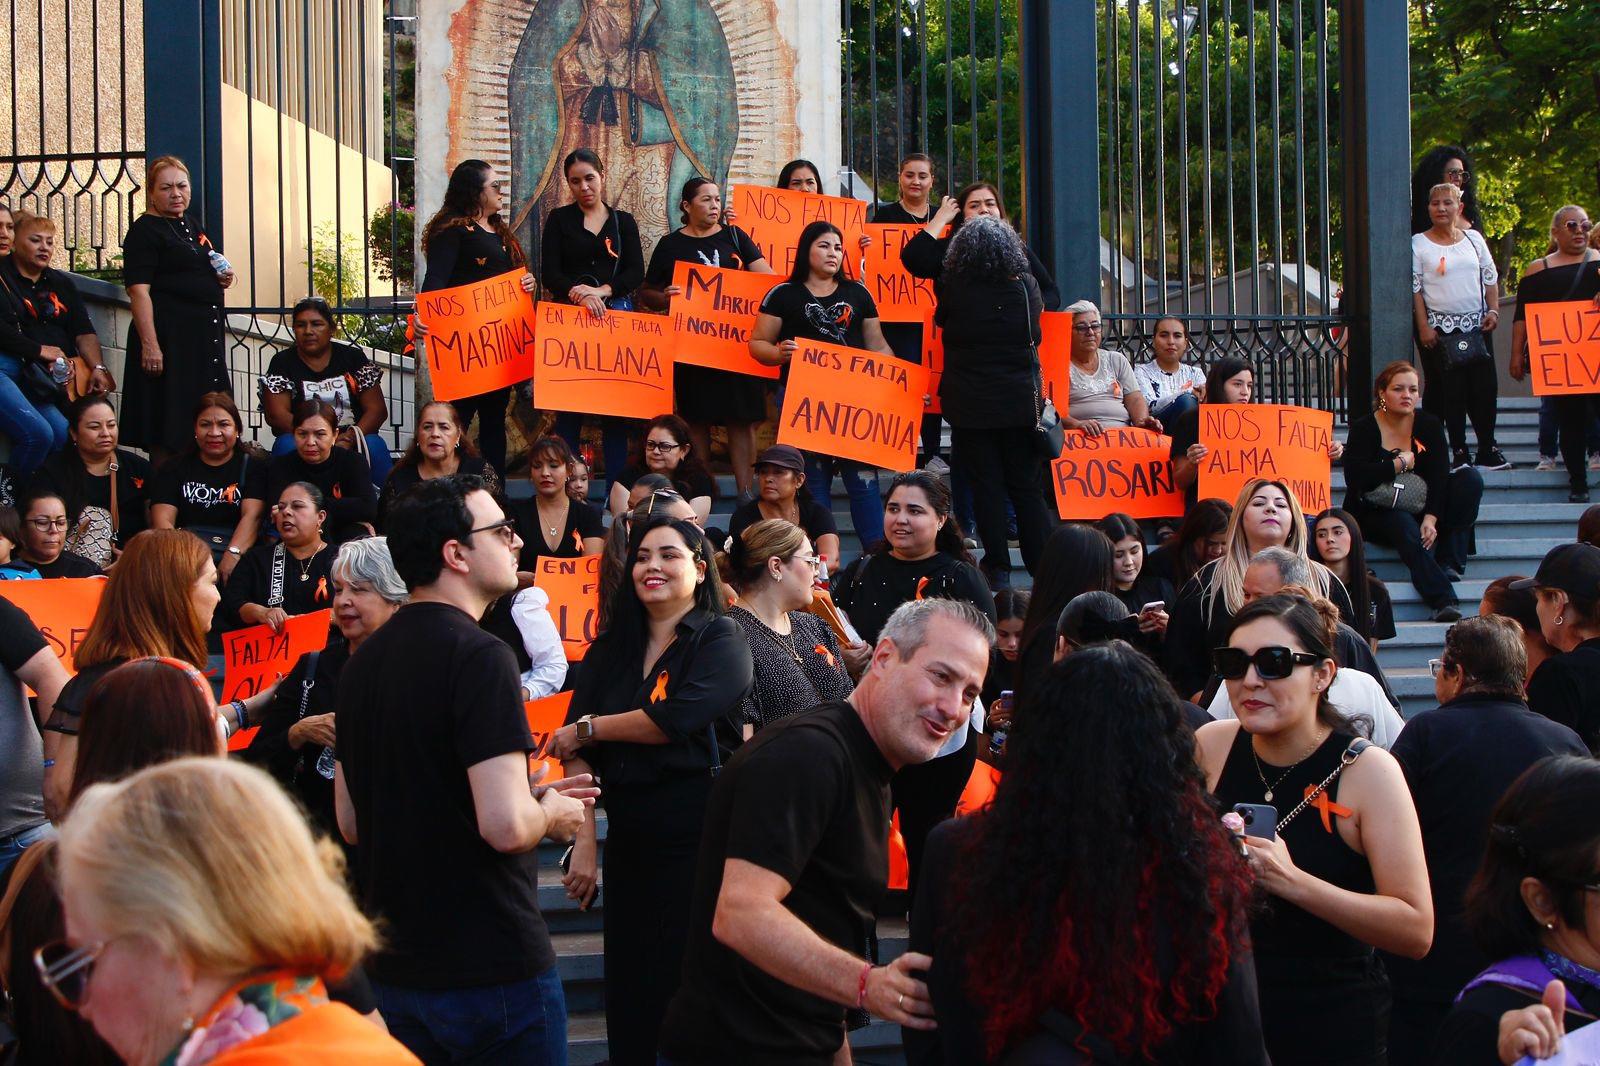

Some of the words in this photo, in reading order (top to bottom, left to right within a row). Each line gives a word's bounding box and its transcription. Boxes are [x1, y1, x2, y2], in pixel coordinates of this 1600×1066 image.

[744, 189, 791, 224] NOS
[803, 197, 864, 232] FALTA
[426, 294, 465, 319] NOS
[472, 280, 518, 313] FALTA
[685, 268, 759, 316] MARIC
[877, 273, 935, 306] MAR
[545, 307, 564, 325] EN
[632, 318, 662, 336] FALTA
[674, 312, 750, 343] #NOSHAC
[431, 316, 536, 373] MARTINA
[543, 338, 662, 378] DALLANA
[306, 380, 344, 392] CHIC
[802, 348, 842, 371] NOS
[850, 355, 908, 392] FALTA
[1541, 353, 1600, 388] ELV
[790, 397, 915, 455] ANTONIA
[1063, 432, 1101, 450] NOS
[1206, 409, 1260, 441] NOS
[1278, 410, 1331, 458] FALTA
[1055, 459, 1175, 499] ROSARI
[1208, 447, 1277, 475] ALMA
[182, 484, 242, 500] WOMN
[1243, 477, 1328, 511] MINA
[543, 560, 576, 574] EN
[231, 631, 290, 668] FALTA
